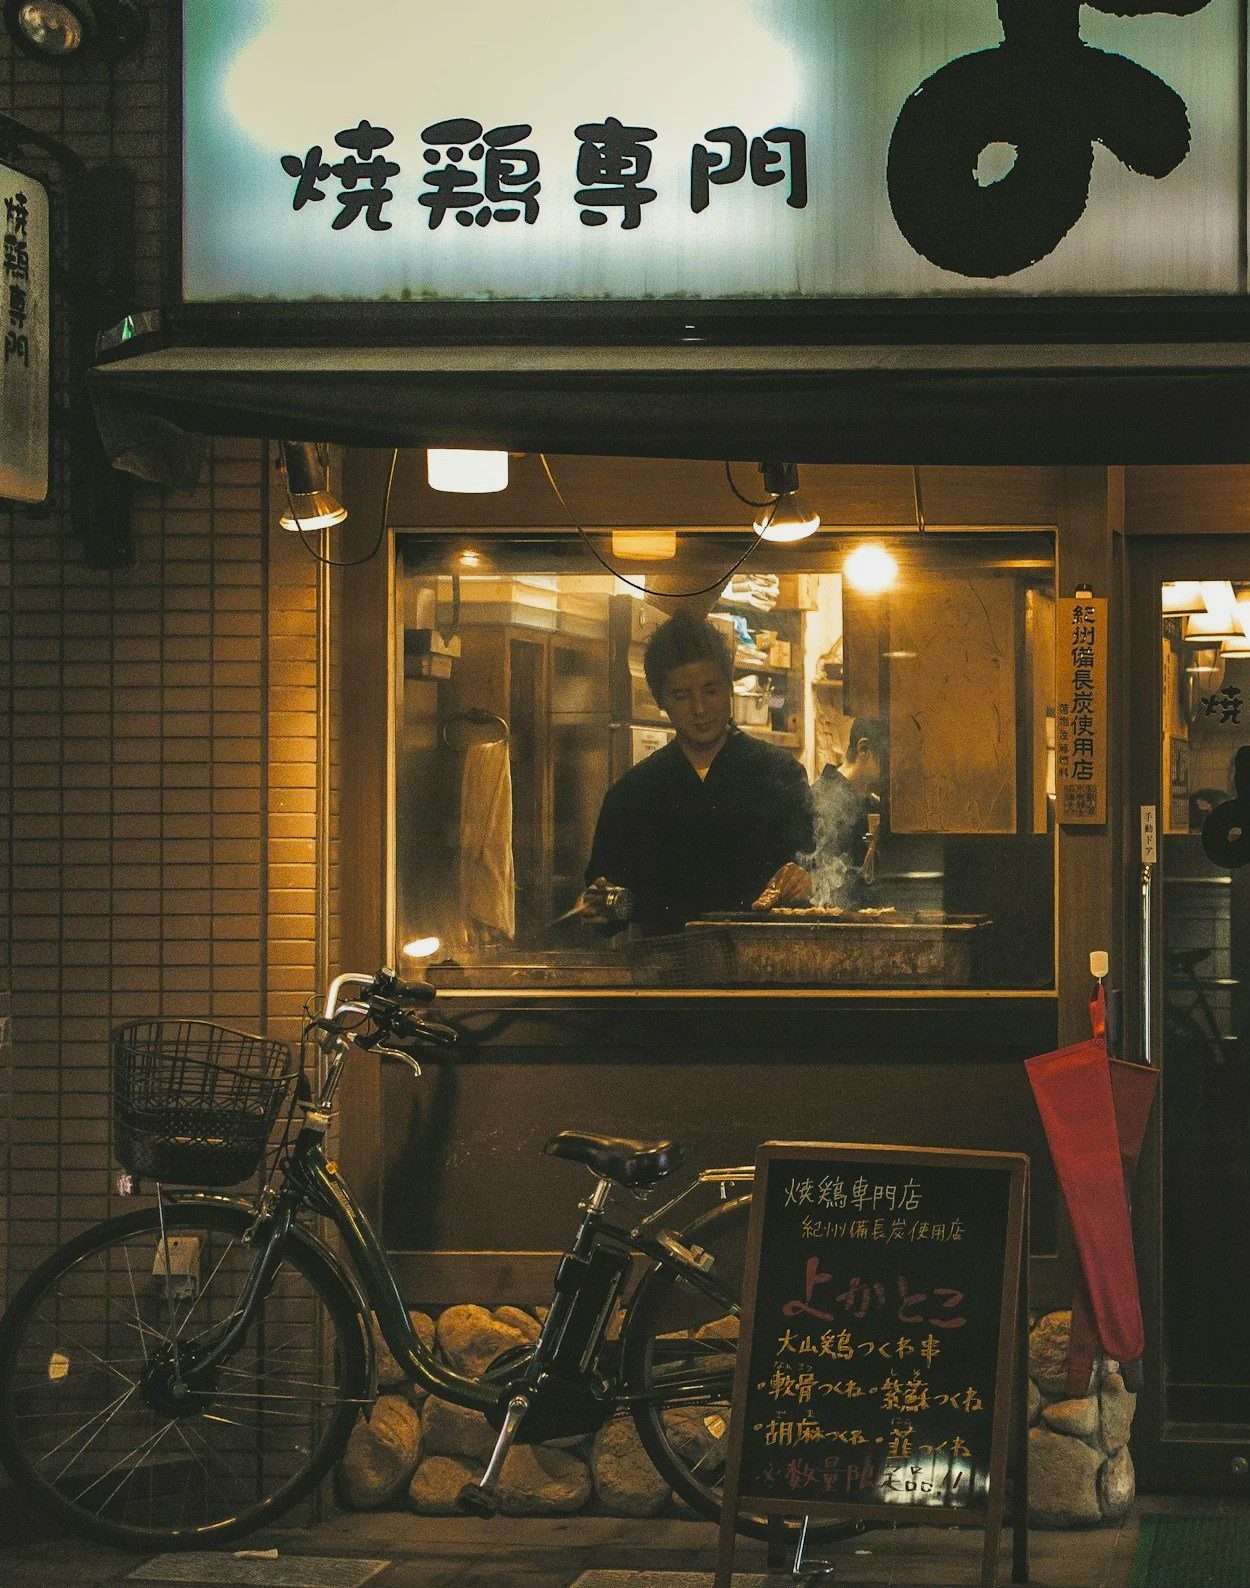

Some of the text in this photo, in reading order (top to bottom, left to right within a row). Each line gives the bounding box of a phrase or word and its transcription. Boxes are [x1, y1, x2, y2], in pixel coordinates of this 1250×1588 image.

[280, 117, 808, 231] 焼鶏専門
[1070, 605, 1097, 781] 紀州備長炭使用店
[784, 1175, 923, 1212] 焼鶏専門店
[801, 1215, 966, 1244] 紀州備長炭使用店
[782, 1256, 967, 1329] よかとこ
